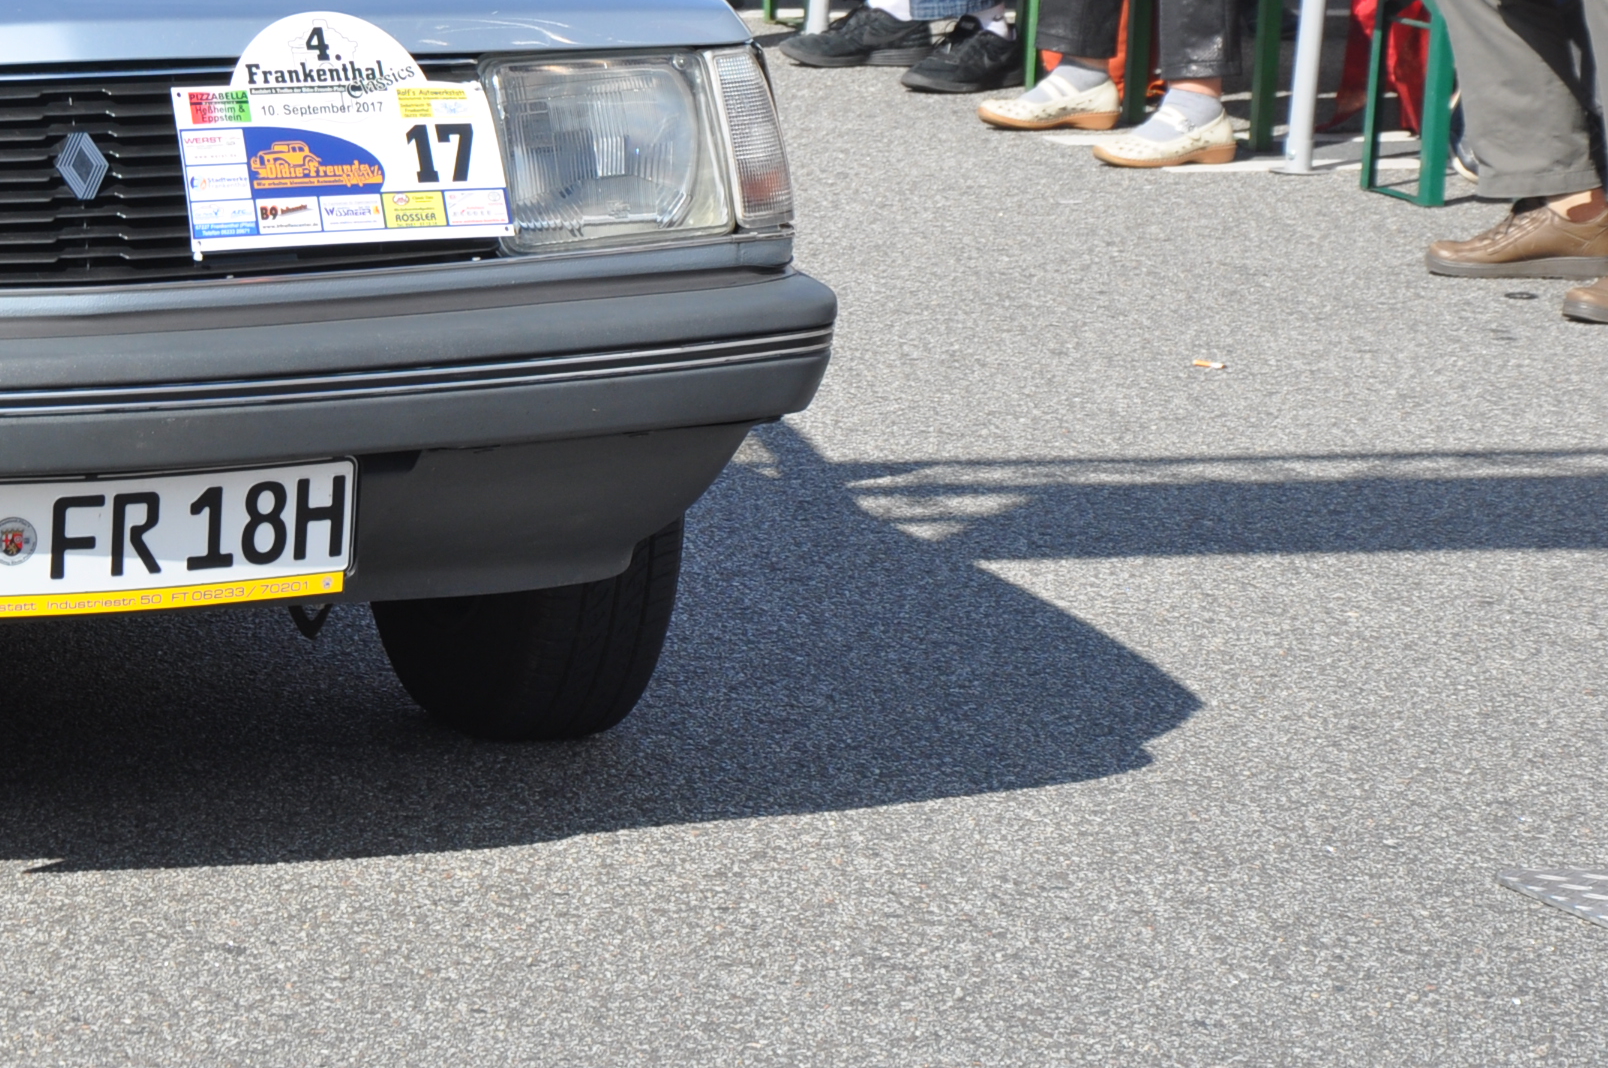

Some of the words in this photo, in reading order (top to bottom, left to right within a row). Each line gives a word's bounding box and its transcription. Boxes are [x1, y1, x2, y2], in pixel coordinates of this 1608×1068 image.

[306, 27, 342, 61] 4.
[245, 60, 385, 85] Frankenthal
[347, 66, 415, 98] Classics
[195, 106, 236, 115] Heßheim
[238, 105, 245, 113] &
[201, 114, 242, 124] Eppstein
[261, 105, 279, 116] 10.
[284, 104, 352, 117] September
[356, 102, 383, 113] 2017
[405, 123, 473, 183] 17
[266, 160, 367, 179] Oldie-Freunde
[260, 205, 278, 220] B9
[50, 491, 161, 580] FR
[187, 474, 346, 571] 18H
[47, 597, 136, 611] Industriestr.
[141, 594, 163, 606] 50
[171, 592, 190, 603] FT
[260, 581, 310, 595] 70201
